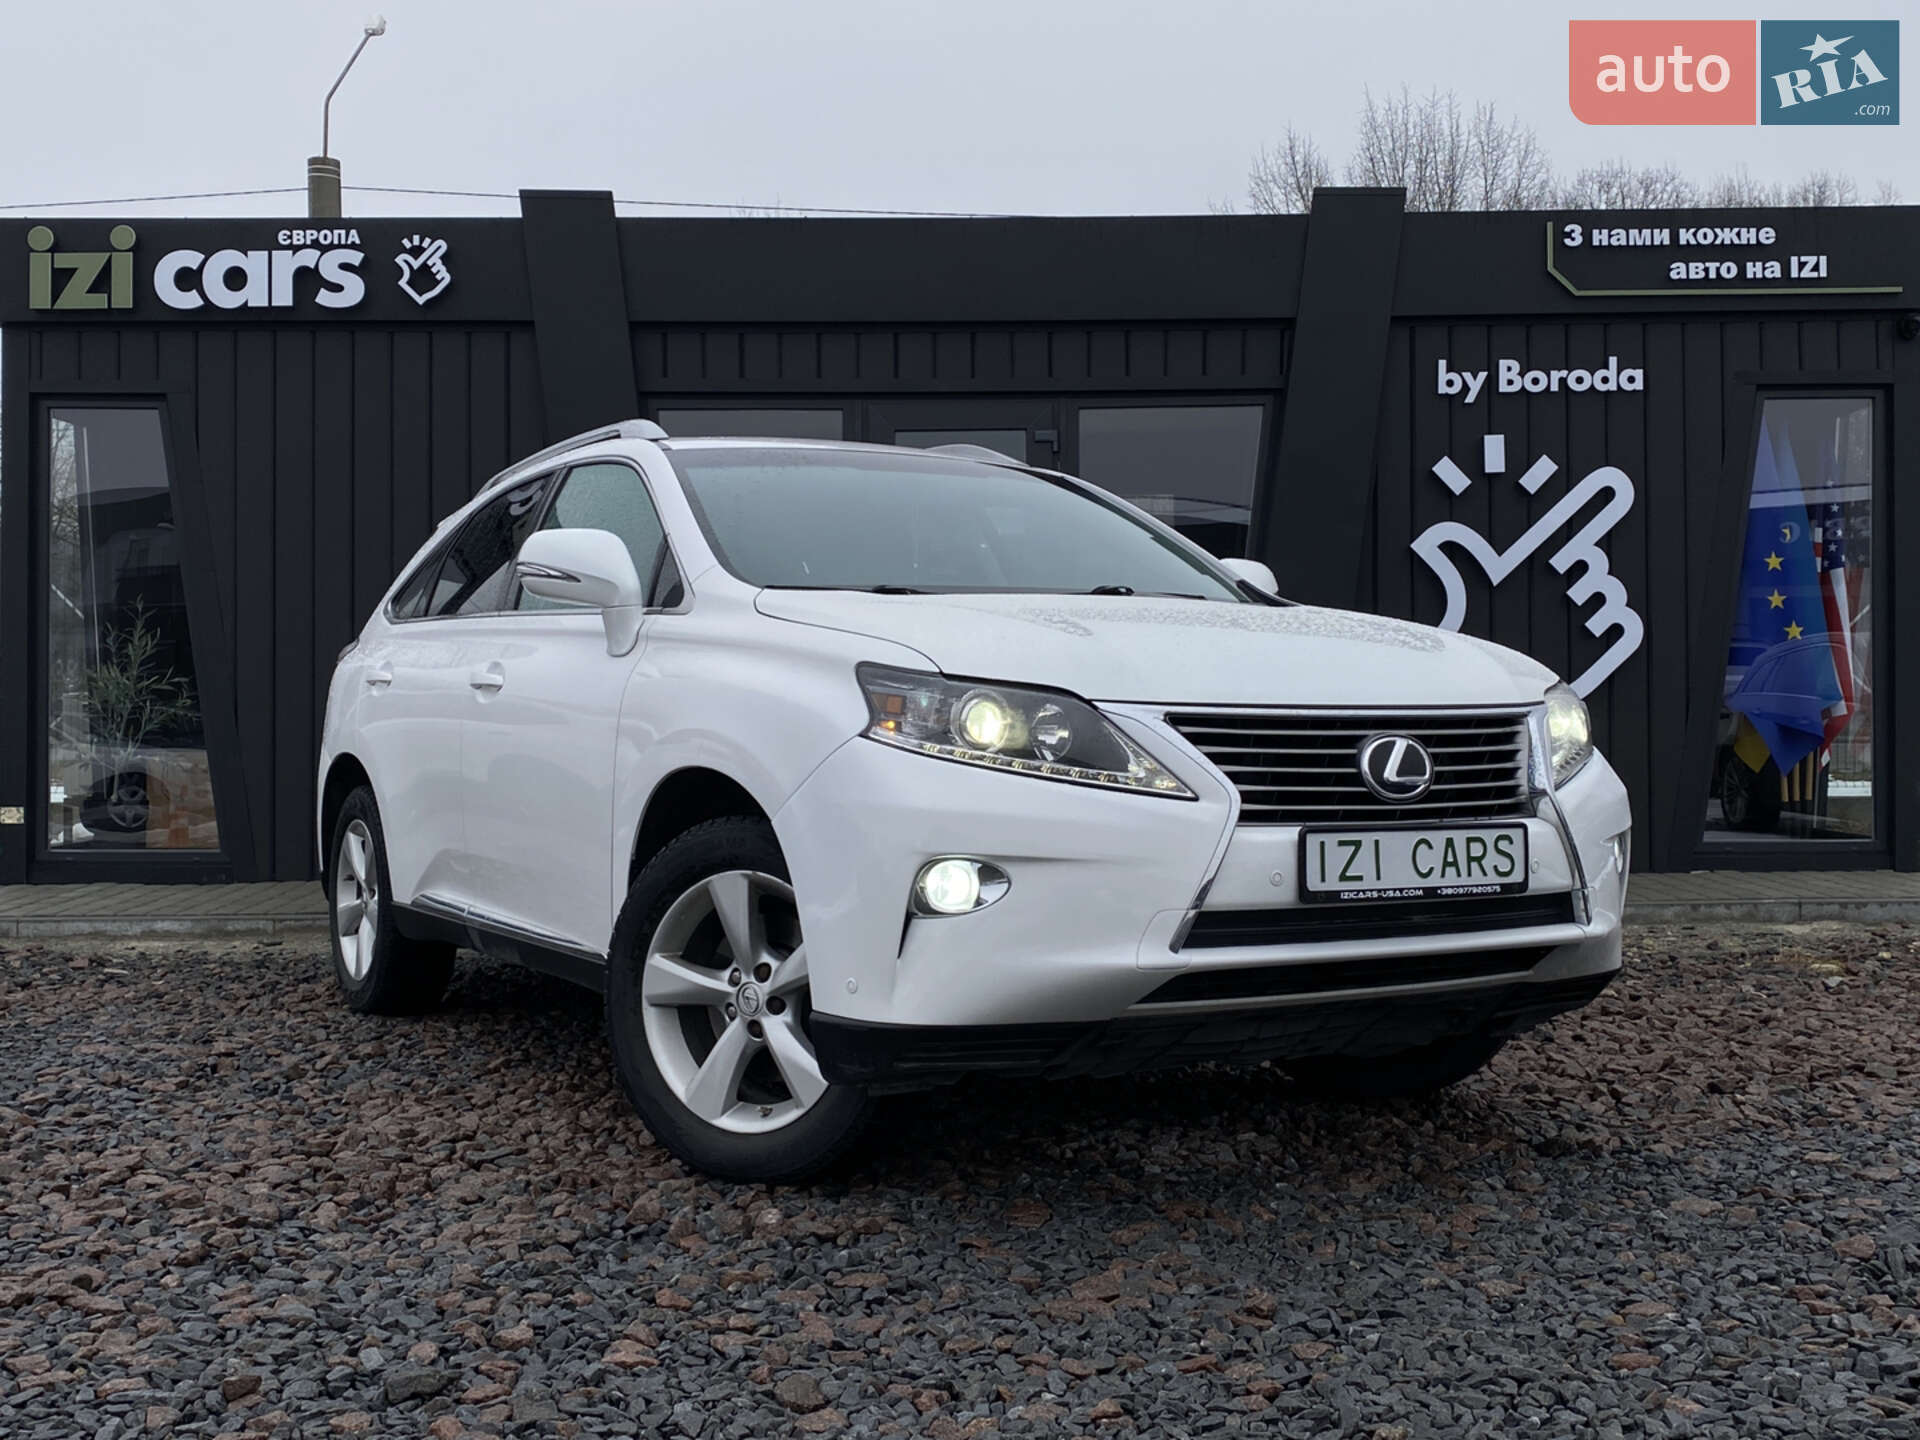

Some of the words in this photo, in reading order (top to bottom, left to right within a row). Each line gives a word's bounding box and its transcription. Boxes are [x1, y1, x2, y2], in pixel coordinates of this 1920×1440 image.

[277, 229, 360, 245] ЄВРОПА
[1592, 228, 1670, 246] нами
[1679, 227, 1776, 245] кожне
[27, 225, 136, 309] izi
[154, 249, 365, 309] cars
[1669, 260, 1738, 279] авто
[1746, 260, 1781, 278] на
[1790, 256, 1828, 278] IZI
[1438, 359, 1488, 403] by
[1498, 356, 1644, 393] Boroda
[1319, 839, 1382, 883] IZI
[1411, 834, 1516, 880] CARS
